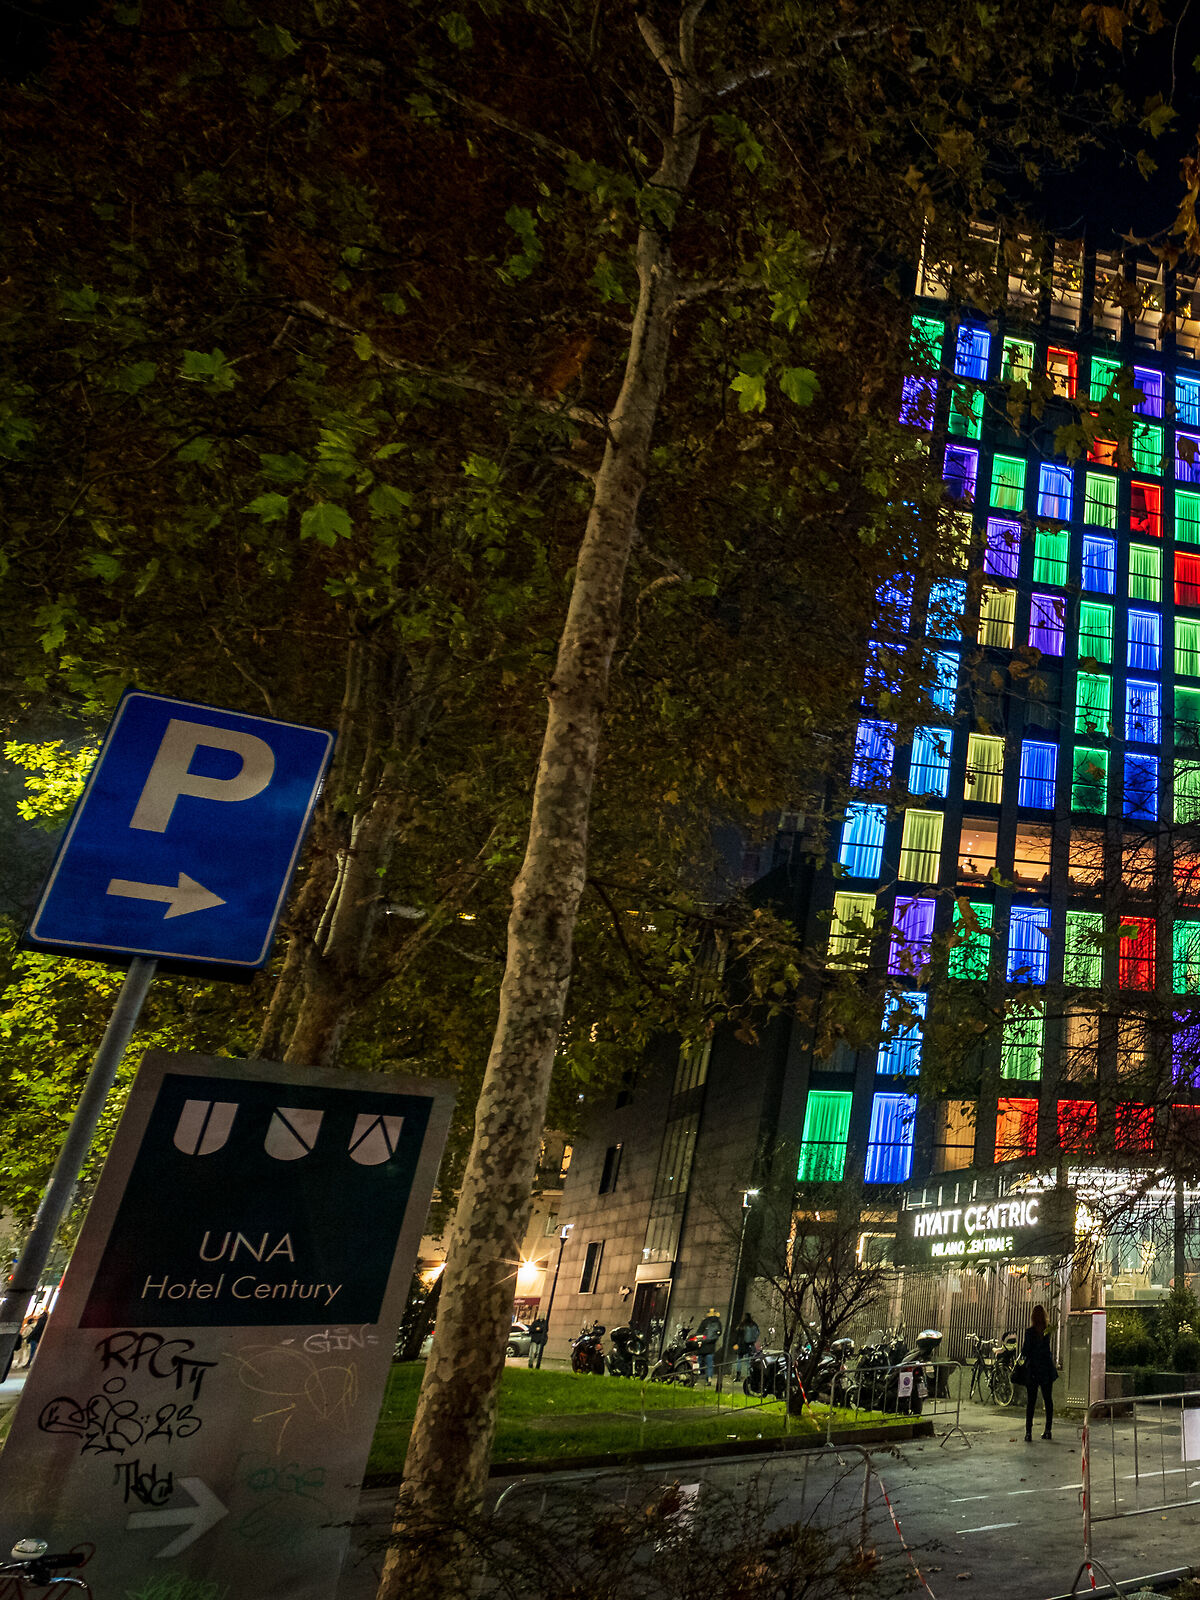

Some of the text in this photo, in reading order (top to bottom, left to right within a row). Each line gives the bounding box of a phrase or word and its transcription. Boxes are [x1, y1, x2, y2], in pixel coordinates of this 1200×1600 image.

[129, 719, 275, 833] P
[914, 1199, 1039, 1236] HYATT CENTRIC
[199, 1230, 296, 1263] UNA
[931, 1240, 965, 1257] MILANO
[141, 1273, 343, 1306] Hotel Century
